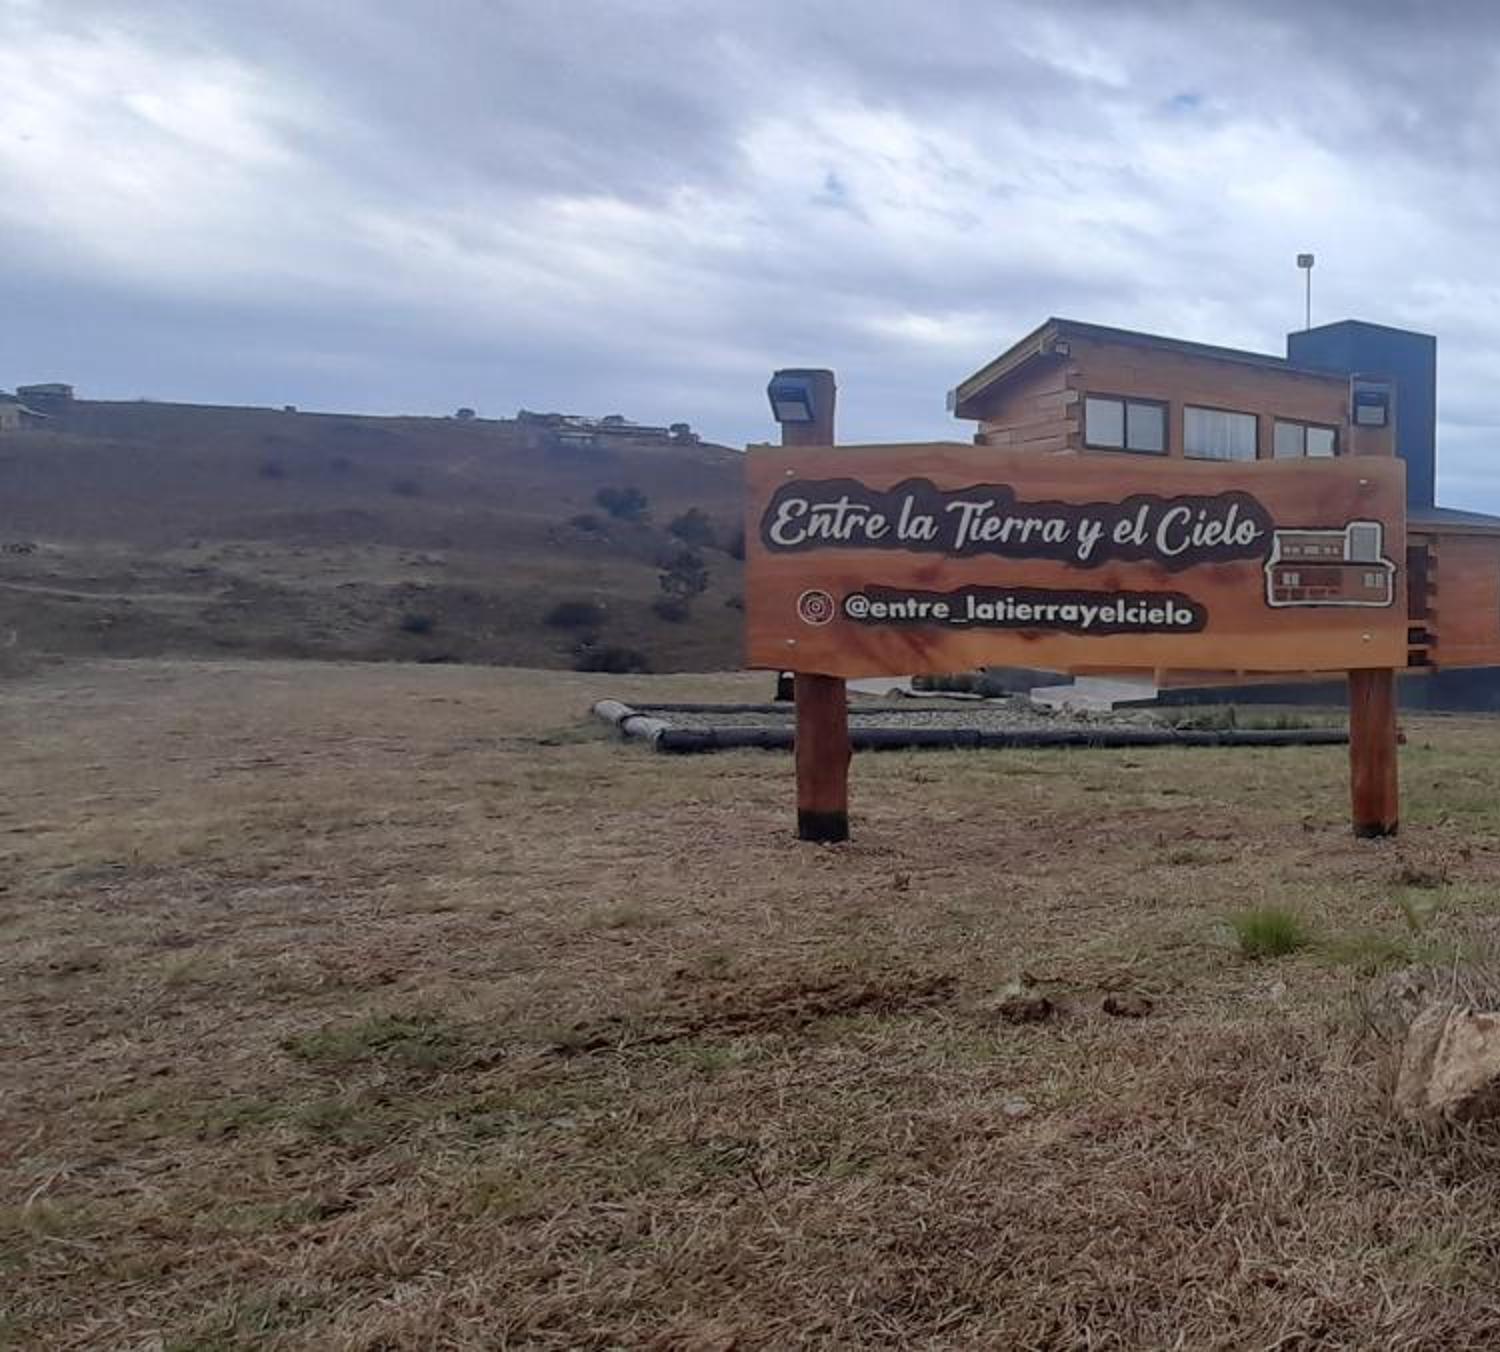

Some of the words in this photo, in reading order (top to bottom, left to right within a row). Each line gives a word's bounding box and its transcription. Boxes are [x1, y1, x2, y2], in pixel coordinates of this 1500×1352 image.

[770, 497, 890, 546] Entre
[896, 497, 938, 541] la
[945, 500, 1067, 549] Tierra
[1077, 517, 1105, 560] y
[1113, 504, 1149, 546] el
[1156, 503, 1263, 556] Cielo
[845, 595, 1193, 631] @entre_latierrayelcielo
